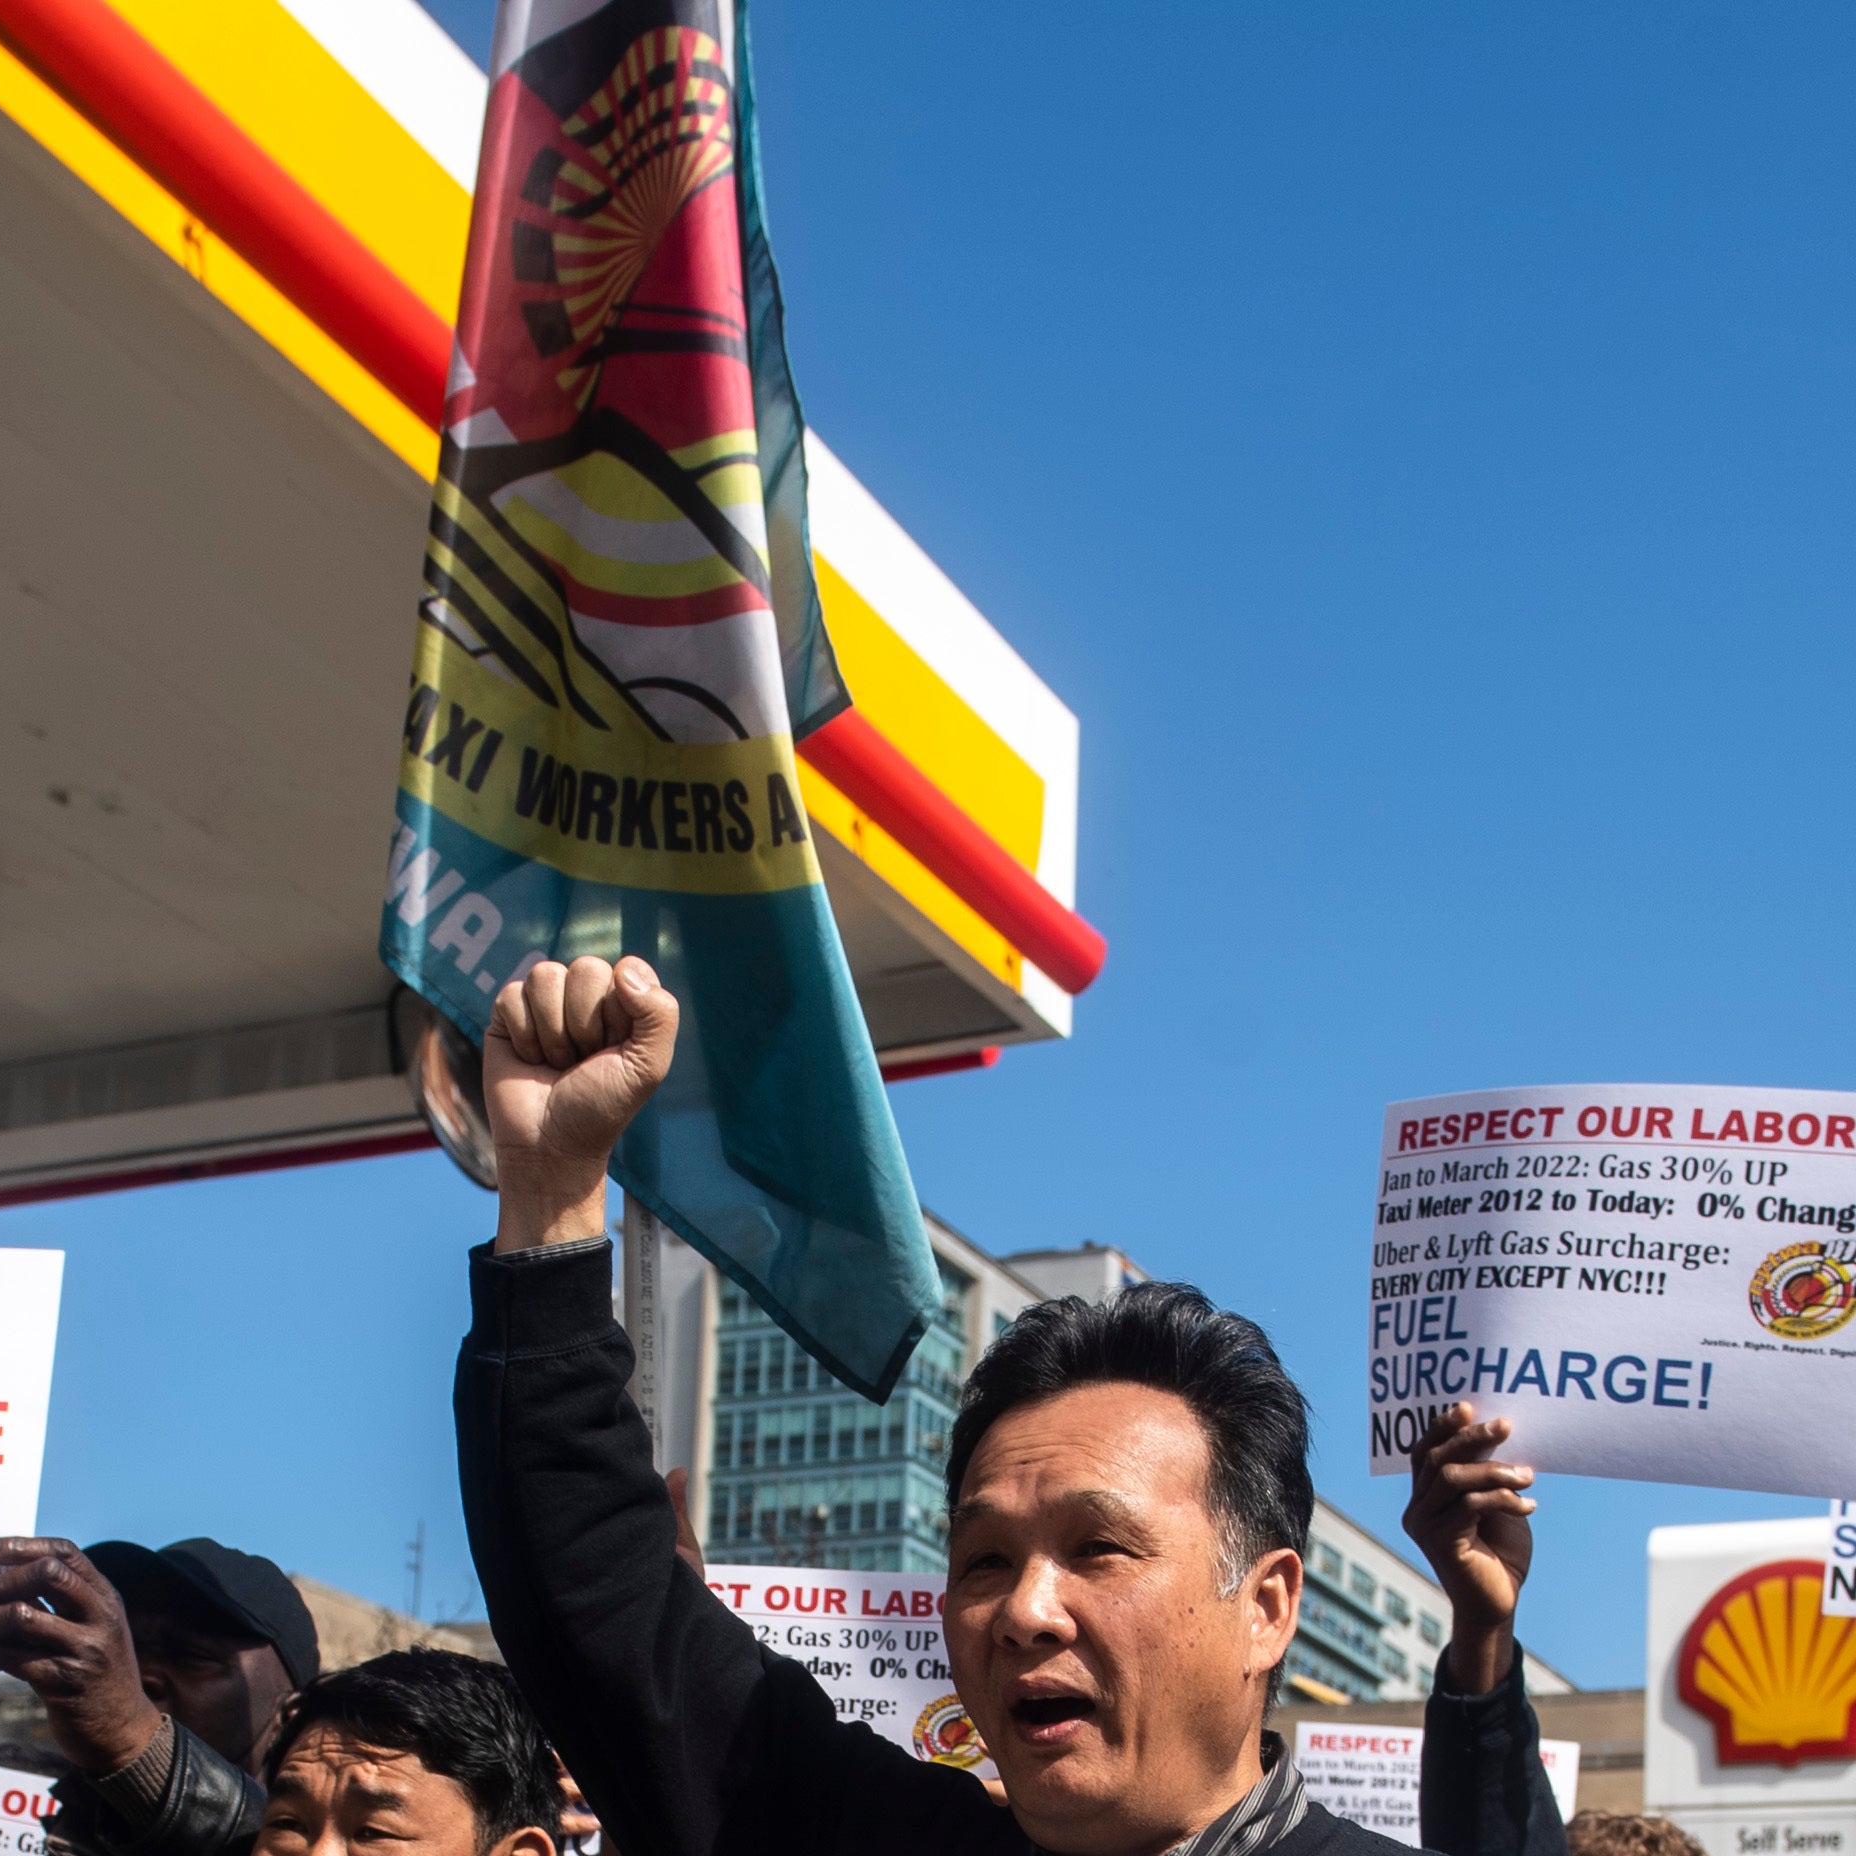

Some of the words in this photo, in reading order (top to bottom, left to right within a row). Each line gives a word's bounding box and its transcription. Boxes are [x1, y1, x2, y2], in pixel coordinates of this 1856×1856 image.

[403, 677, 503, 794] AXI
[515, 745, 753, 853] WORKERS
[1398, 1107, 1564, 1152] RESPECT
[1577, 1106, 1674, 1139] OUR
[1382, 1170, 1413, 1197] Jan
[1416, 1167, 1436, 1187] to
[1440, 1161, 1510, 1184] March
[1517, 1155, 1589, 1179] 2022:
[1599, 1153, 1651, 1180] Gas
[1660, 1156, 1733, 1185] 30%
[1744, 1159, 1788, 1187] UP
[1376, 1200, 1413, 1226] Taxi
[1416, 1196, 1472, 1220] Meter
[1479, 1188, 1542, 1214] 2012
[1552, 1191, 1576, 1213] to
[1587, 1190, 1674, 1219] Today:
[1697, 1193, 1744, 1219] 0%
[1374, 1239, 1420, 1267] Uber
[1425, 1235, 1442, 1260] &
[1448, 1232, 1494, 1260] Lyft
[1499, 1232, 1549, 1258] Gas
[1556, 1232, 1730, 1271] Surcharge:
[1371, 1275, 1421, 1301] EVERY
[1426, 1270, 1470, 1292] CITY
[1476, 1267, 1568, 1290] EXCEPT
[1578, 1268, 1666, 1296] NYC!!!
[1372, 1296, 1468, 1350] FUEL
[1701, 1337, 1741, 1349] Justice.
[1744, 1341, 1778, 1353] Rights.
[1782, 1346, 1826, 1357] Respect.
[1371, 1348, 1713, 1410] SURCHARGE!
[764, 1585, 847, 1614] OUR
[787, 1626, 831, 1647] Gas
[839, 1629, 897, 1652] 30%
[905, 1630, 938, 1651] UP
[870, 1657, 907, 1679] 0%
[1309, 1734, 1414, 1755] RESPECT
[1737, 1826, 1777, 1852] Self
[1784, 1827, 1842, 1851] Serve
